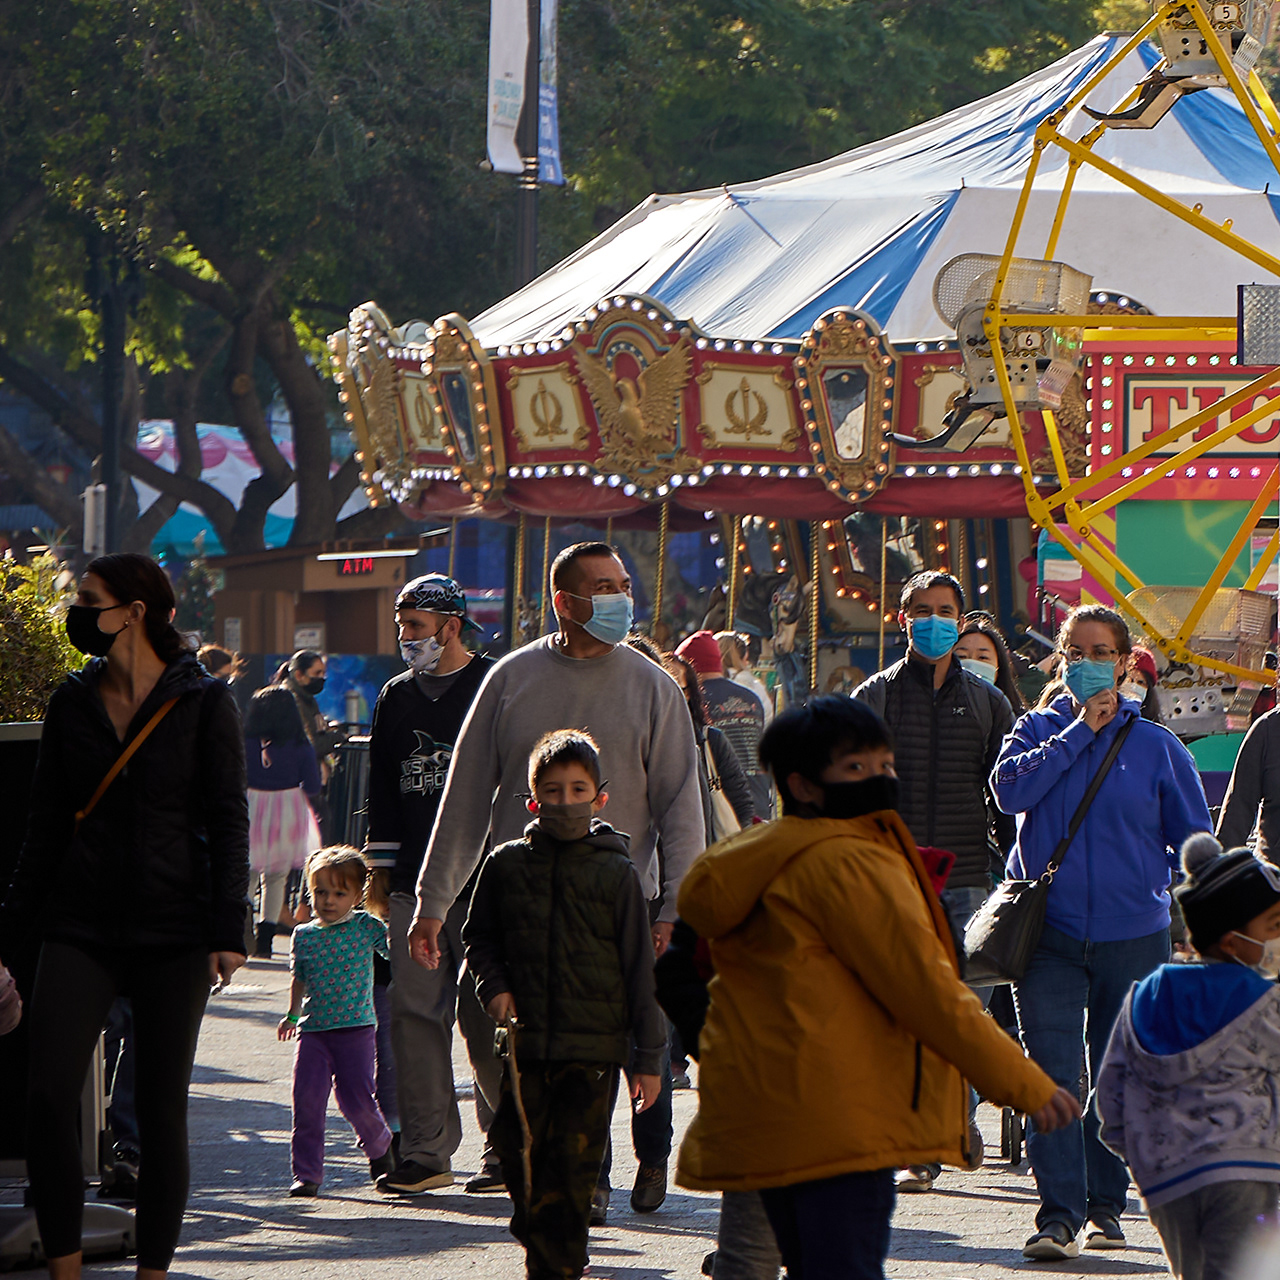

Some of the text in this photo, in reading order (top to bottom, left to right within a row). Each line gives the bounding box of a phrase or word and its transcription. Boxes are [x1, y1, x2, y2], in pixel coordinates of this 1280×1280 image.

[1222, 3, 1231, 20] 5
[1025, 334, 1033, 347] 6
[342, 558, 374, 574] ATM
